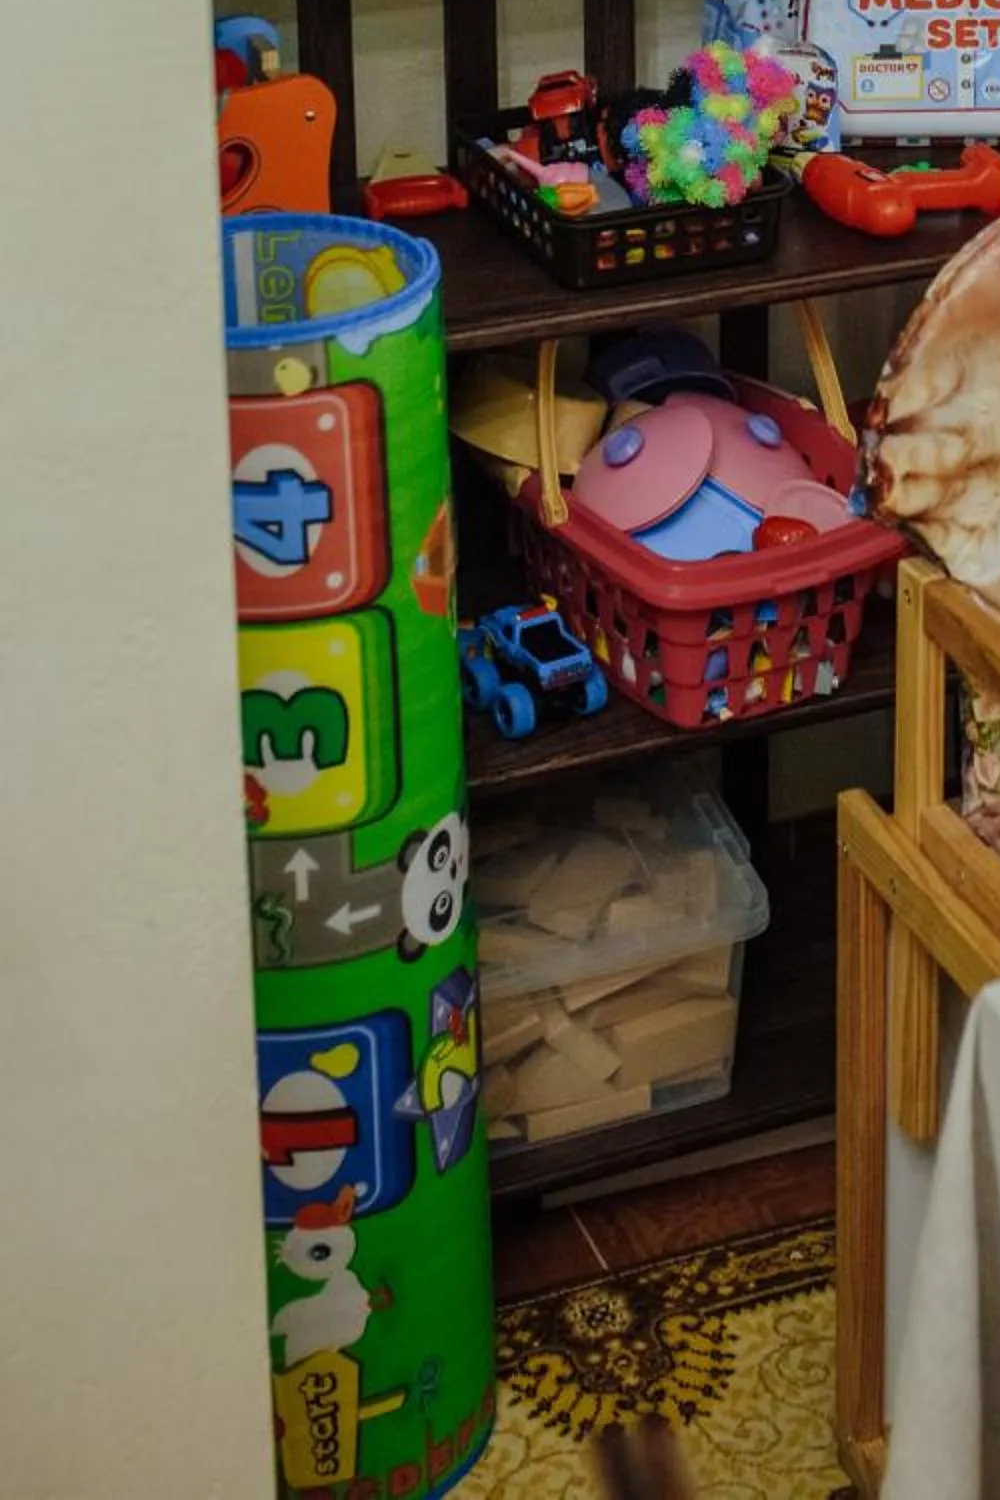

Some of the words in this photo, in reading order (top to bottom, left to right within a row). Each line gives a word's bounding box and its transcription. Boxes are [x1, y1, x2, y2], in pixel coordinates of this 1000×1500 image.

[858, 63, 905, 73] DOCTOR
[233, 468, 332, 565] 4
[299, 1371, 340, 1477] start
